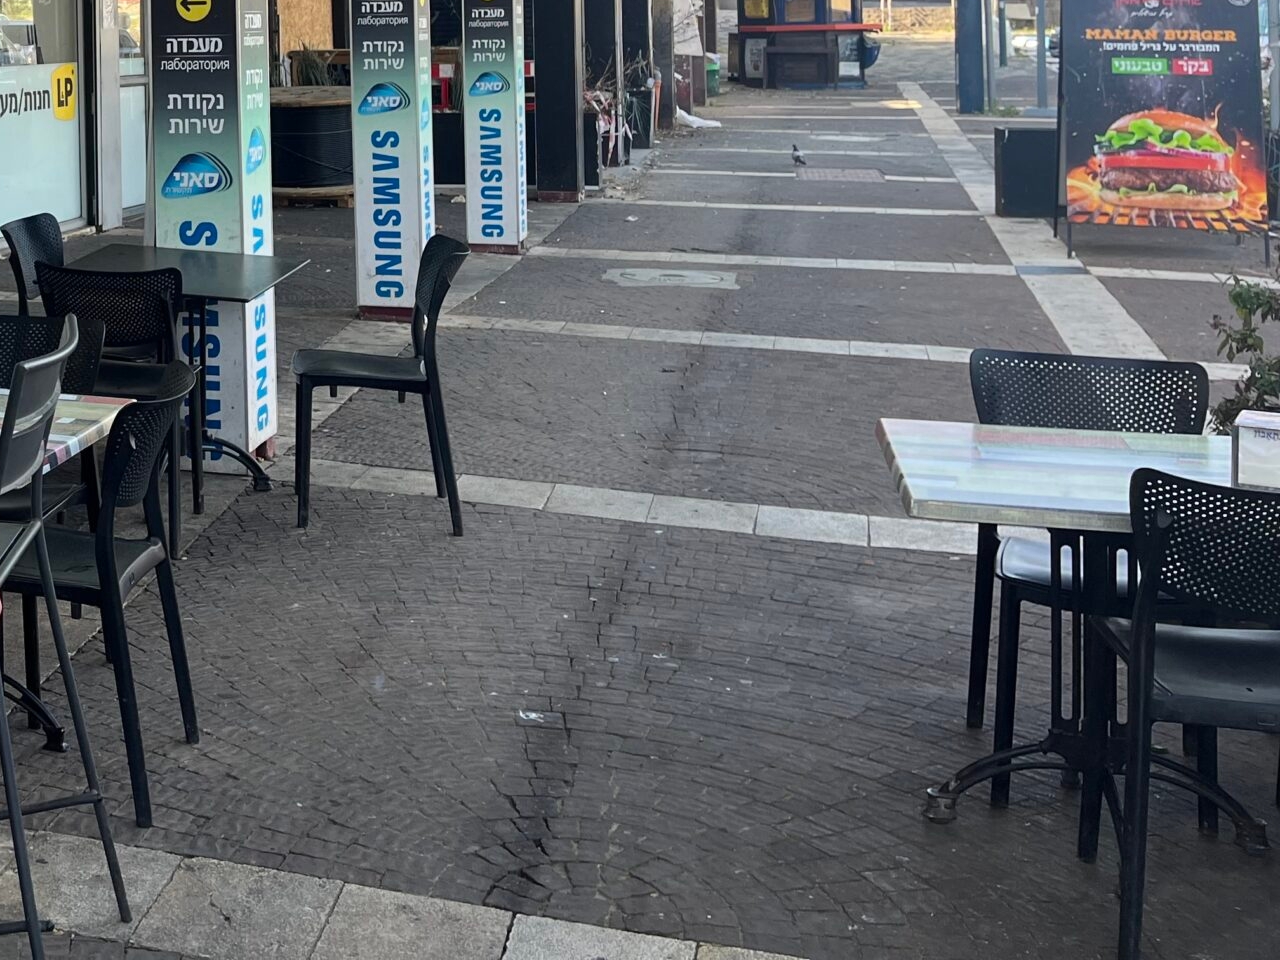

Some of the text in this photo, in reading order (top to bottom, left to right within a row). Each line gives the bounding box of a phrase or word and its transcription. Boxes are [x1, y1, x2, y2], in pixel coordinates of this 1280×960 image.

[361, 1, 404, 14] מעבדה
[471, 9, 505, 19] מעבדה
[357, 15, 409, 27] лаборатория
[468, 19, 509, 28] лаборатория
[1085, 28, 1237, 42] MAMAN BURGER
[166, 38, 223, 54] מעבדה
[361, 40, 405, 57] נקודת
[472, 38, 506, 50] נקודת
[1140, 42, 1161, 51] גריל
[1163, 42, 1176, 51] על
[1178, 43, 1220, 52] המבורגר
[473, 51, 506, 62] שירות
[160, 58, 230, 73] лаборатория
[363, 58, 405, 70] שירות
[1114, 60, 1163, 72] טבעוני
[1177, 58, 1209, 74] בקר
[475, 81, 503, 91] סאני
[167, 94, 225, 116] נקודת
[366, 96, 401, 108] סאני
[168, 119, 225, 134] שירות
[478, 108, 505, 238] SAMSUNG
[173, 172, 220, 188] סאני
[371, 130, 404, 298] SAMSUNG
[251, 194, 269, 432] SASUNG
[1254, 430, 1280, 441] תאבון
